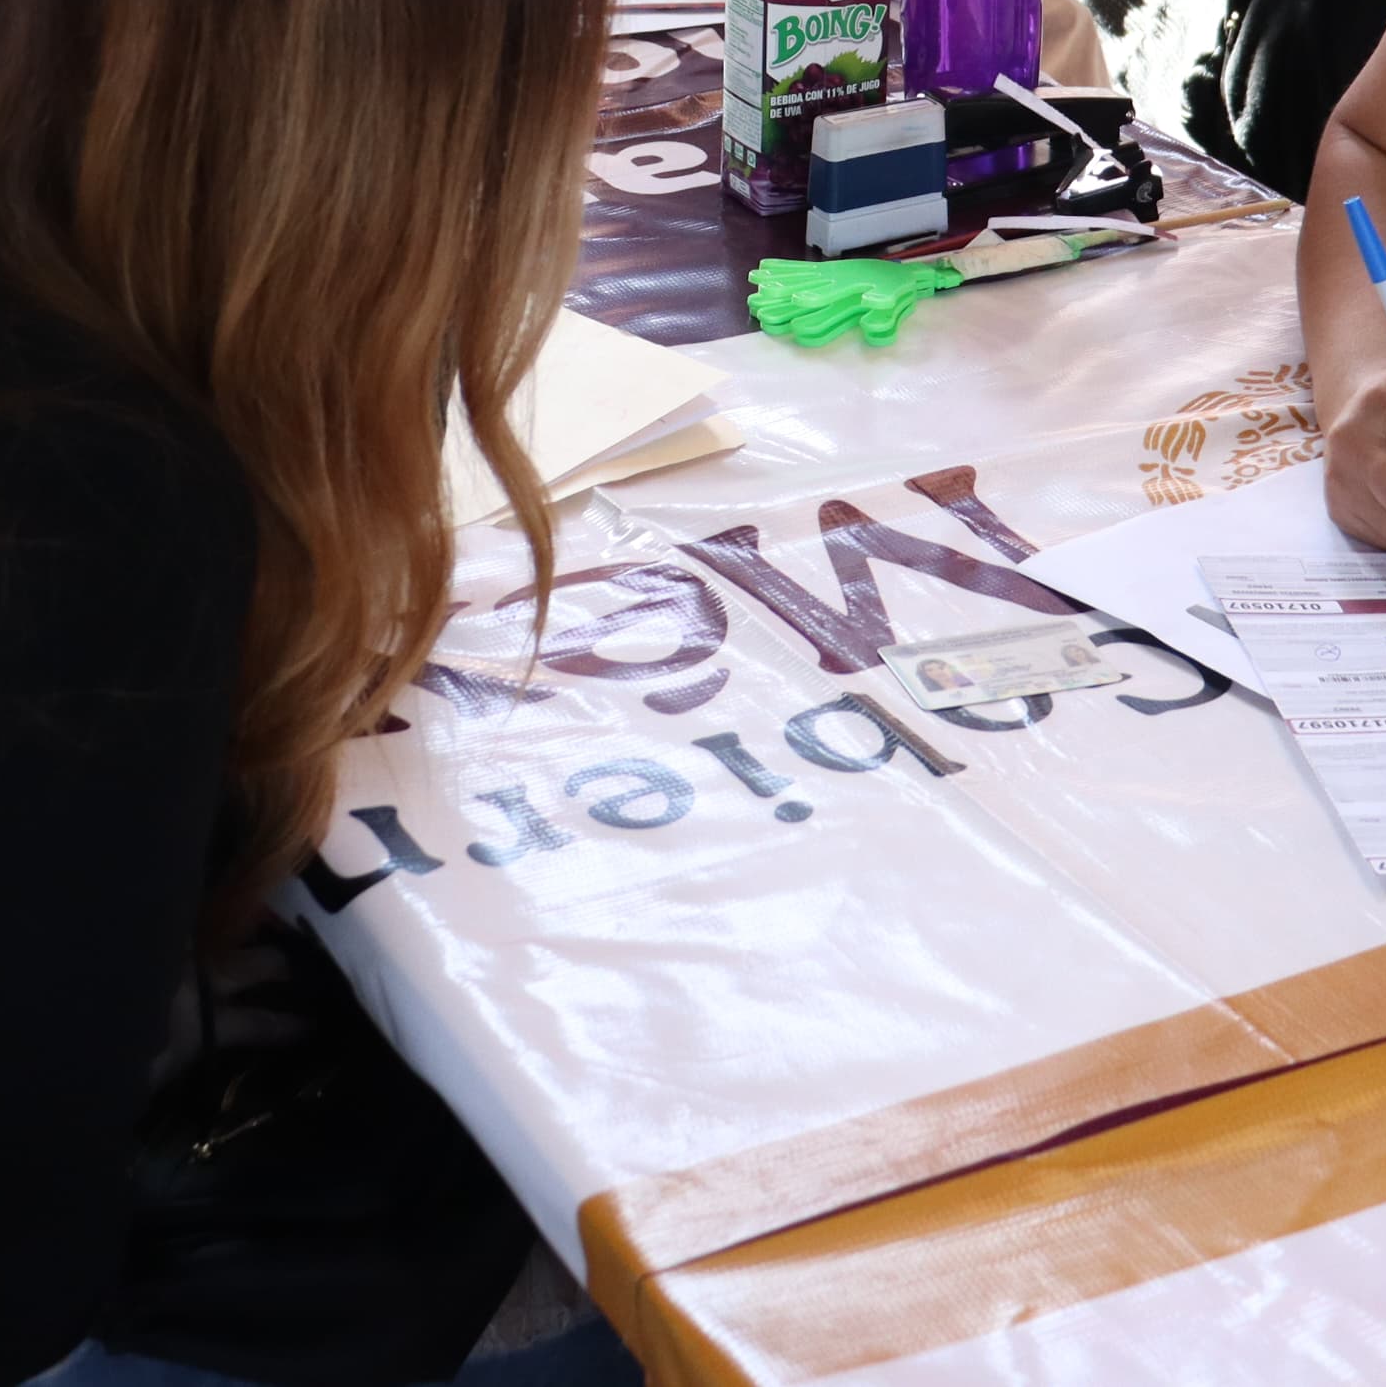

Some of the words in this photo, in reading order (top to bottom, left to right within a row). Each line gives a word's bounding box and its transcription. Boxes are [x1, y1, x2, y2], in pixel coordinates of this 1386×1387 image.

[771, 4, 887, 68] BOING!
[770, 93, 804, 107] BEBIDA
[805, 89, 824, 102] CON
[826, 86, 845, 100] 11%
[846, 83, 858, 94] DE
[859, 79, 881, 93] JUGO
[770, 107, 782, 119] DE
[784, 104, 802, 117] UVA
[1227, 601, 1322, 612] 01710597
